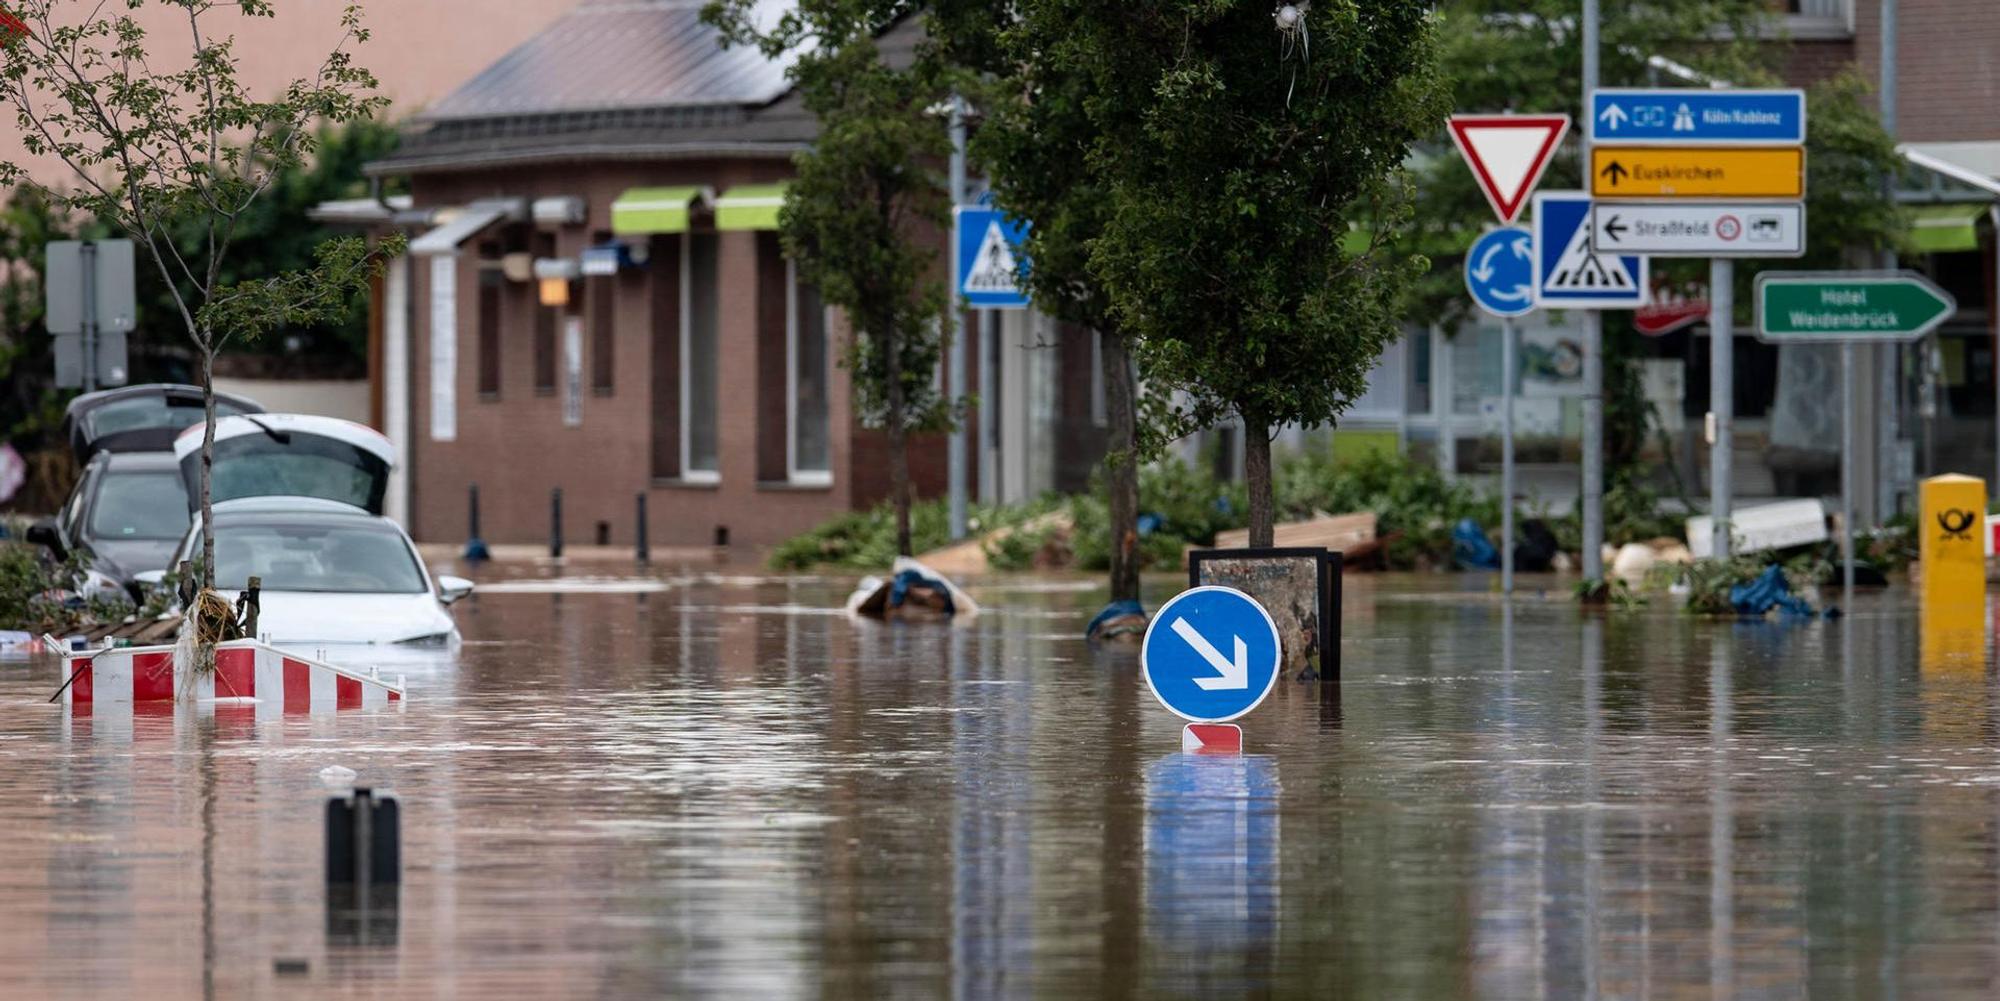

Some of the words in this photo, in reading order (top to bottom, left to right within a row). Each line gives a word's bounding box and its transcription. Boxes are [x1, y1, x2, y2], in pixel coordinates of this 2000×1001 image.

[1633, 164, 1724, 180] Euskirchen
[1635, 220, 1709, 236] Straßfeld
[1821, 288, 1866, 304] Hotel
[1788, 310, 1899, 328] Weidenbrück
